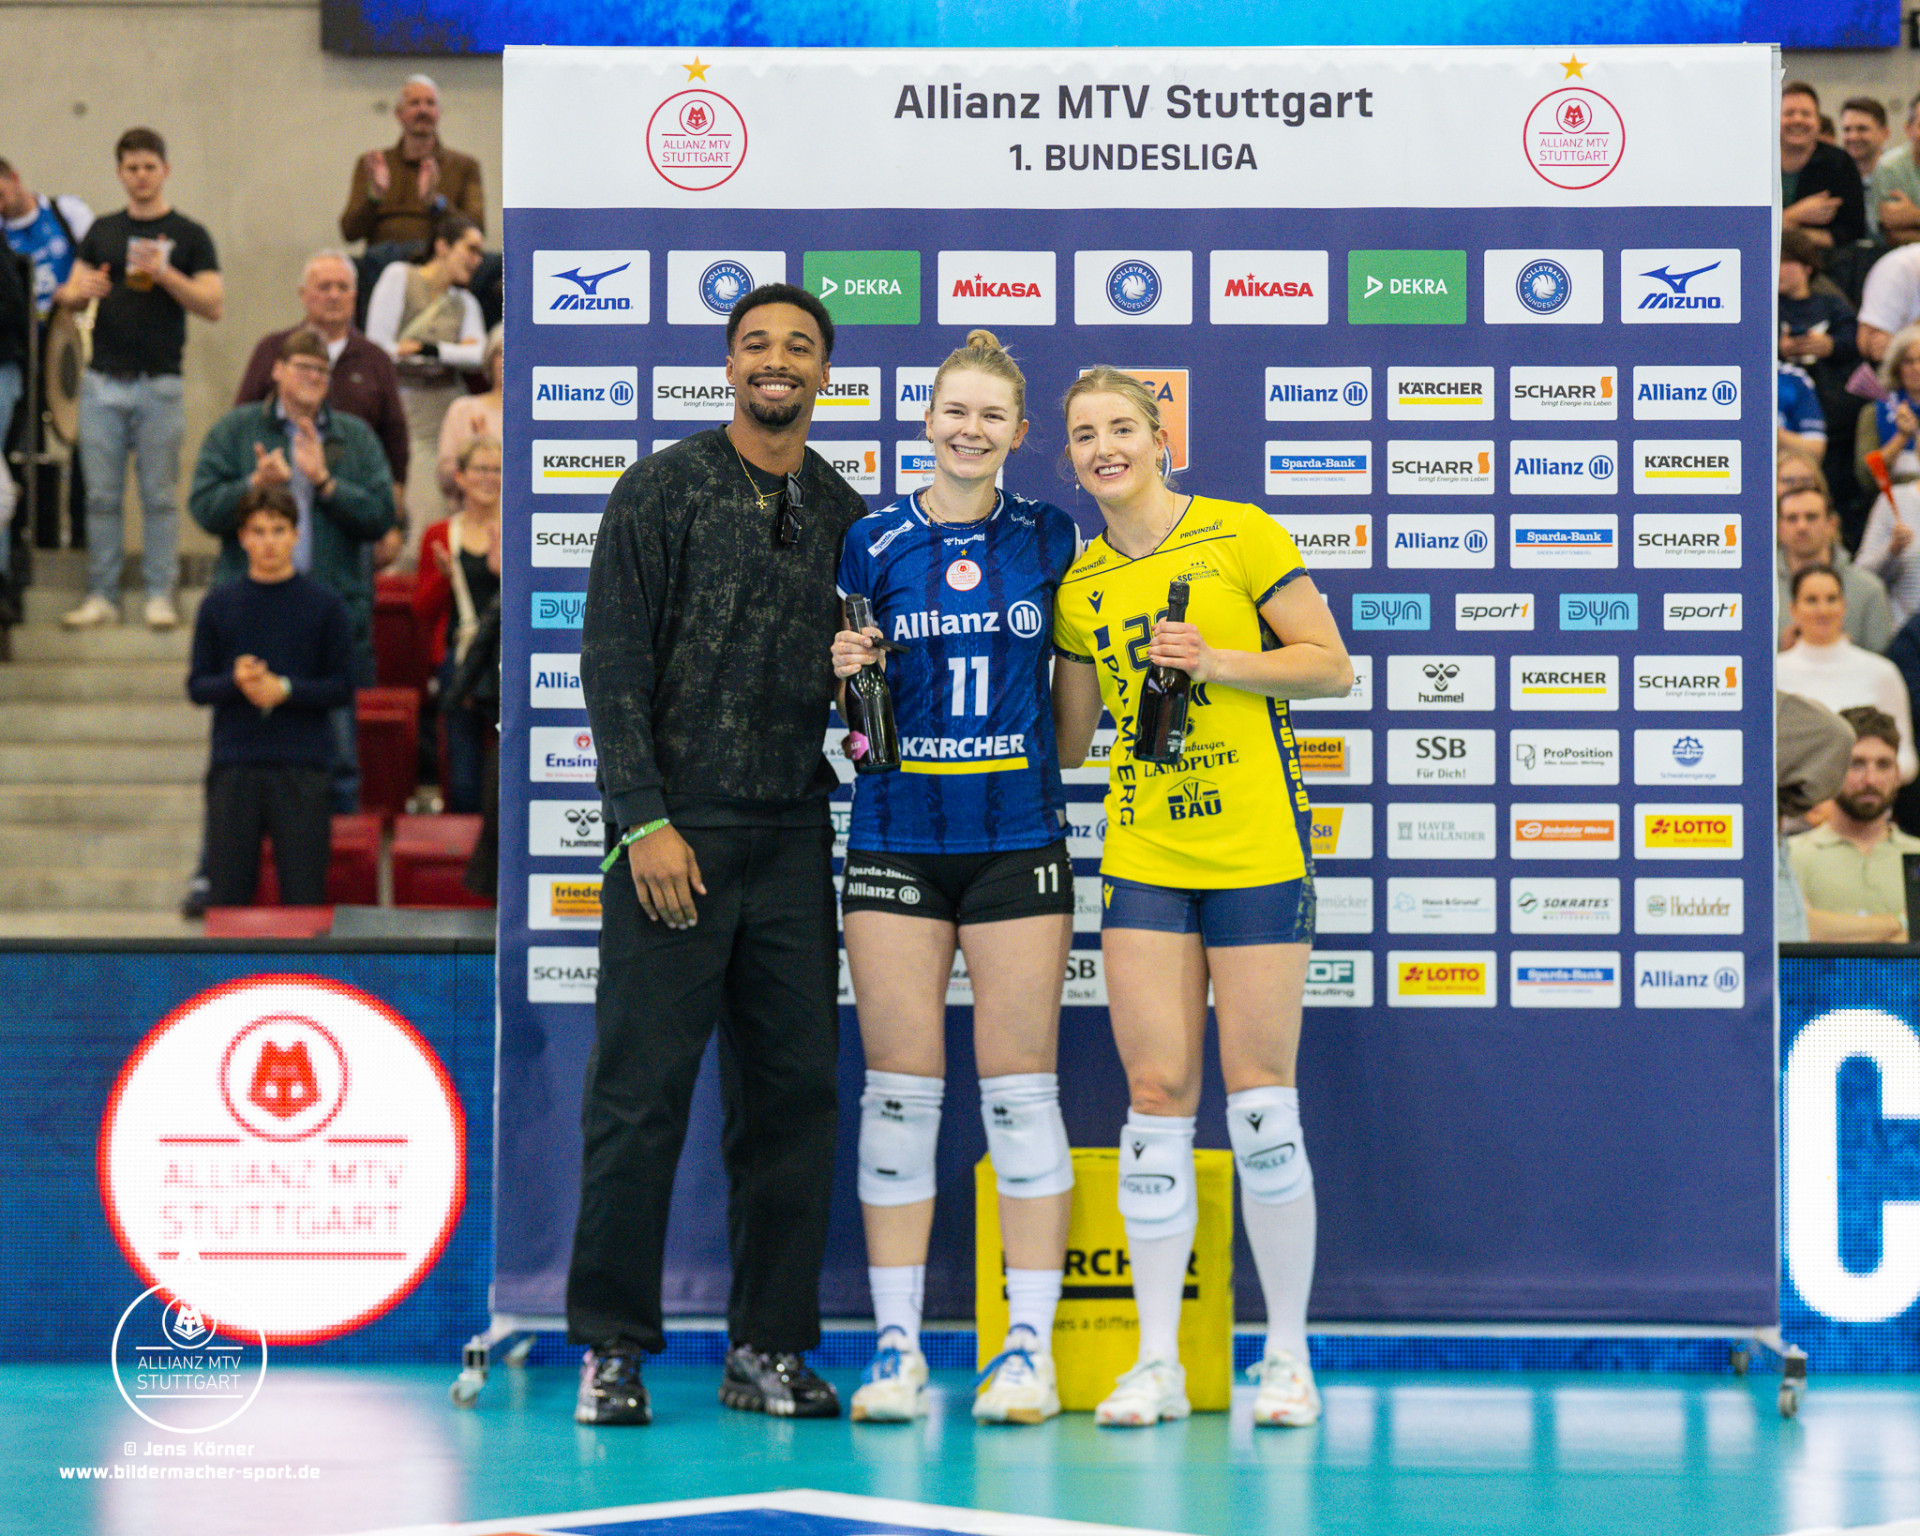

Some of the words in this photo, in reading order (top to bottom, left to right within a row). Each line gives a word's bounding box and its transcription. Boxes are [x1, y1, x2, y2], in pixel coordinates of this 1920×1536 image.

[894, 82, 1041, 119] Allianz
[1058, 84, 1151, 119] MTV
[1166, 83, 1374, 128] Stuttgart
[662, 140, 707, 150] ALLIANZ
[708, 140, 731, 150] MTV
[1539, 138, 1584, 148] ALLIANZ
[1586, 138, 1609, 148] MTV
[662, 152, 731, 163] STUTTGART
[1008, 144, 1033, 171] 1.
[1045, 143, 1258, 171] BUNDESLIGA
[1539, 150, 1609, 162] STUTTGART
[706, 266, 747, 284] VOLLEYBALL
[1112, 266, 1154, 285] VOLLEYBALL
[1522, 265, 1565, 284] VOLLEYBALL
[844, 279, 902, 296] DEKRA
[1389, 278, 1448, 295] DEKRA
[707, 294, 740, 310] BUNDES
[1113, 292, 1155, 311] BUNDESLIGA
[1523, 293, 1565, 310] BUNDESLIGA
[537, 383, 605, 401] Allianz
[657, 386, 736, 399] SCHARR
[816, 384, 870, 396] RCHER
[900, 384, 933, 402] Alli
[1269, 384, 1338, 402] Allianz
[1398, 382, 1483, 395] KÄRCHER
[1514, 385, 1596, 398] SCHARR
[1637, 383, 1707, 401] Allianz
[543, 455, 626, 468] KÄRCHER
[1281, 458, 1356, 470] Sparda-Bank
[1392, 461, 1473, 474] SCHARR
[1514, 458, 1584, 475] Allianz
[1644, 455, 1730, 468] KÄRCHER
[1180, 523, 1221, 539] PROVINZIAL
[1527, 531, 1602, 543] Sparda-Bank
[536, 532, 598, 546] SCHA
[1290, 533, 1350, 547] HARR
[1394, 532, 1460, 549] Allianz
[1638, 533, 1720, 546] SCHARR
[1461, 603, 1529, 621] sport1
[1669, 602, 1737, 621] sport1
[893, 609, 1001, 642] Allianz
[535, 671, 580, 689] Allia
[1522, 671, 1606, 684] KÄRCHER
[1638, 676, 1720, 688] SCHARR
[948, 656, 989, 716] 11
[1418, 692, 1465, 704] hummel
[902, 733, 1026, 759] KÄRCHER
[1416, 736, 1467, 761] SSB
[1543, 747, 1613, 758] ProPosition
[1417, 768, 1435, 779] Für
[1438, 768, 1466, 779] Dich!
[1169, 798, 1223, 821] BAU
[1310, 823, 1333, 838] SB
[1674, 820, 1727, 834] LOTTO
[560, 837, 603, 848] humme
[1034, 863, 1060, 894] 11
[555, 886, 601, 897] friede
[848, 882, 896, 899] Allianz
[1543, 898, 1610, 909] SOKRATES
[533, 967, 599, 980] SCHAR
[1065, 956, 1097, 981] SB
[1427, 968, 1480, 981] LOTTO
[1640, 970, 1709, 988] Allianz
[1093, 1316, 1139, 1331] differ
